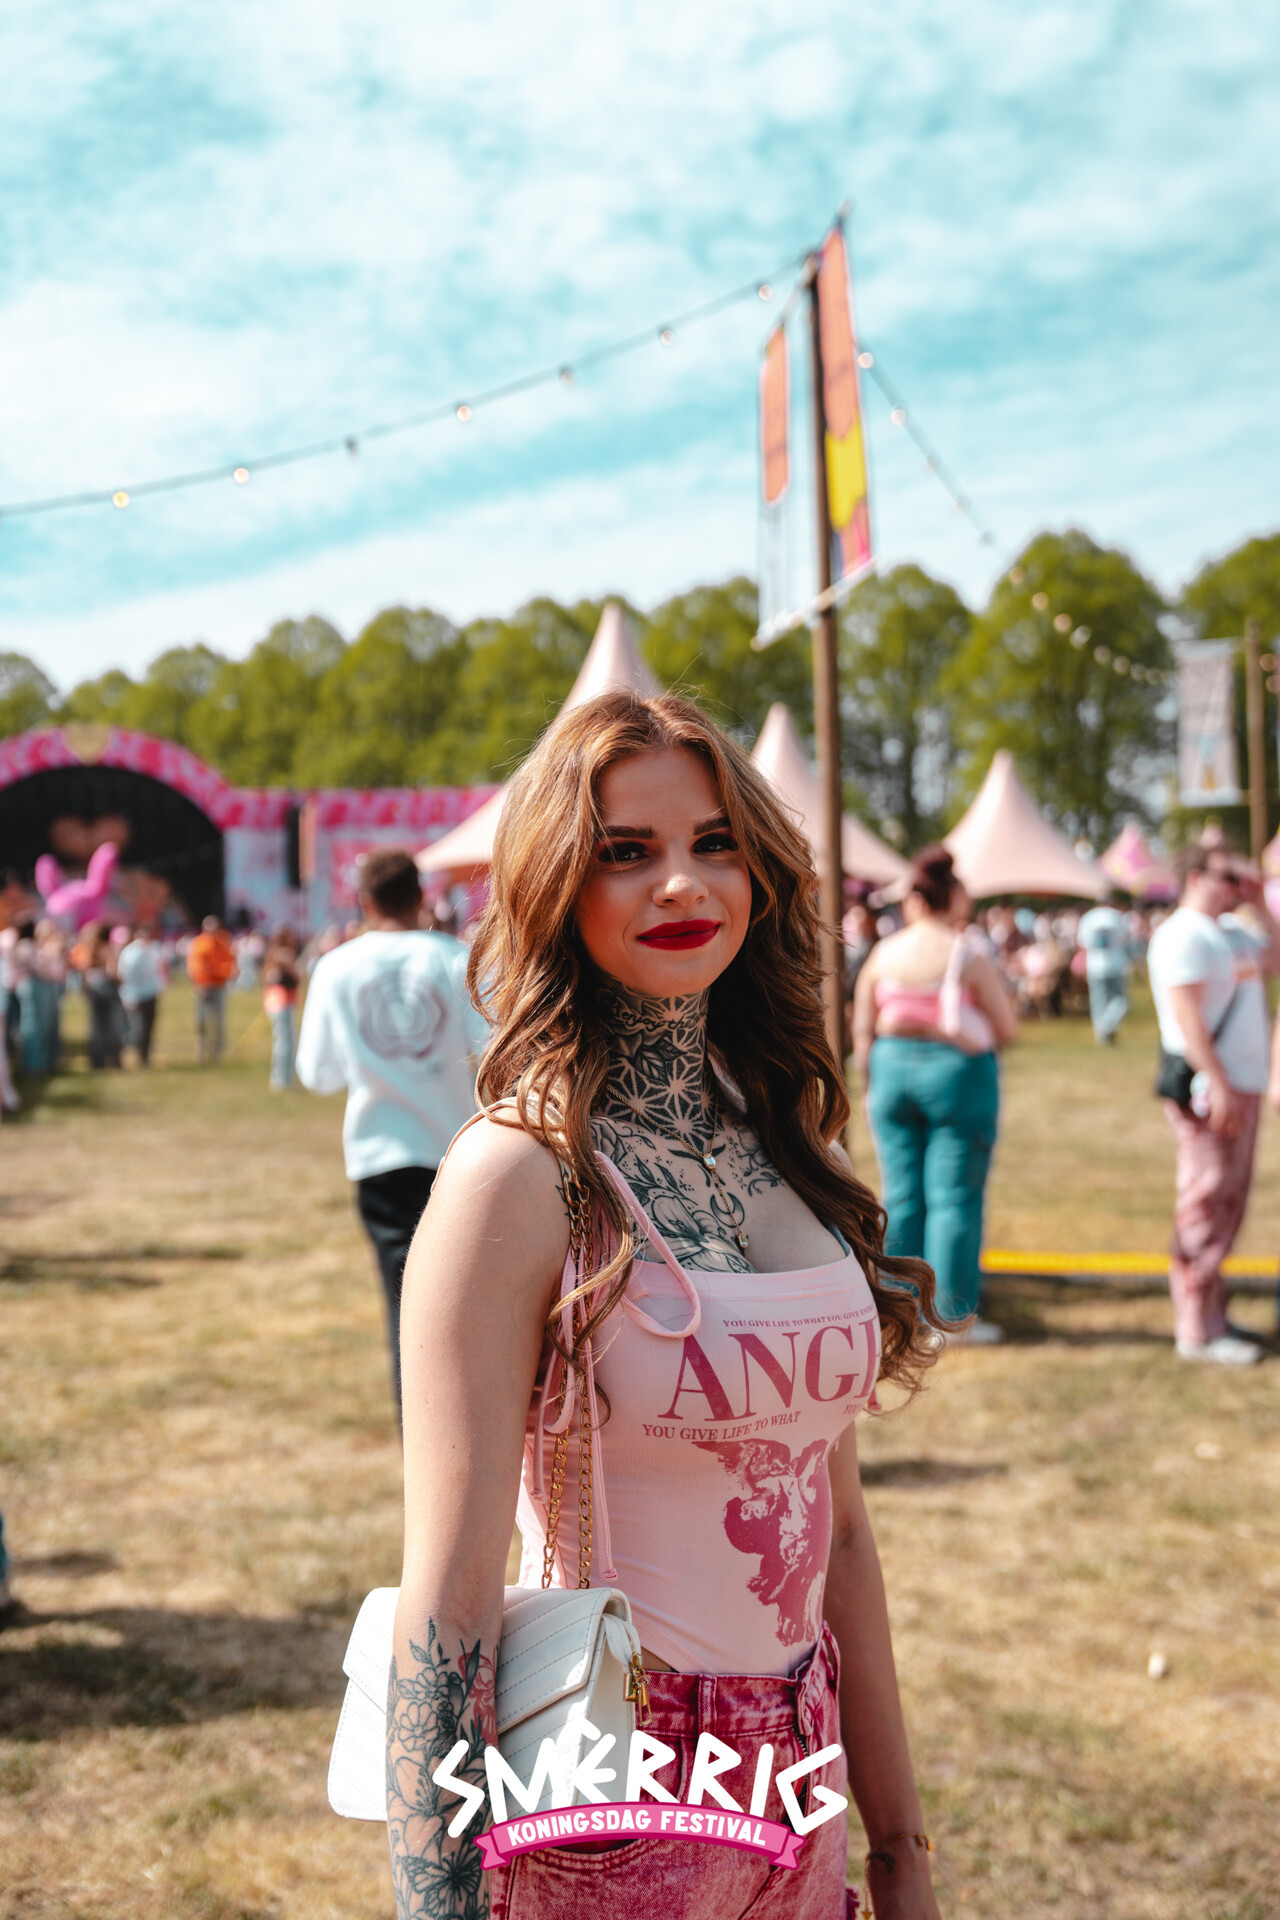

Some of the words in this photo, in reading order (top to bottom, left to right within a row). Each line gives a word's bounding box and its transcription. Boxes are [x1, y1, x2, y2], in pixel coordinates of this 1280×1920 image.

[723, 1319, 747, 1328] YOU
[748, 1319, 771, 1328] GIVE
[772, 1320, 791, 1328] LIFE
[792, 1319, 803, 1327] TO
[803, 1316, 826, 1325] WHAT
[827, 1313, 843, 1322] YOU
[843, 1311, 860, 1320] GIVE
[642, 1423, 675, 1440] YOU
[679, 1427, 719, 1441] GIVE
[722, 1423, 752, 1441] LIFE
[754, 1418, 769, 1432] TO
[770, 1410, 802, 1427] WHAT
